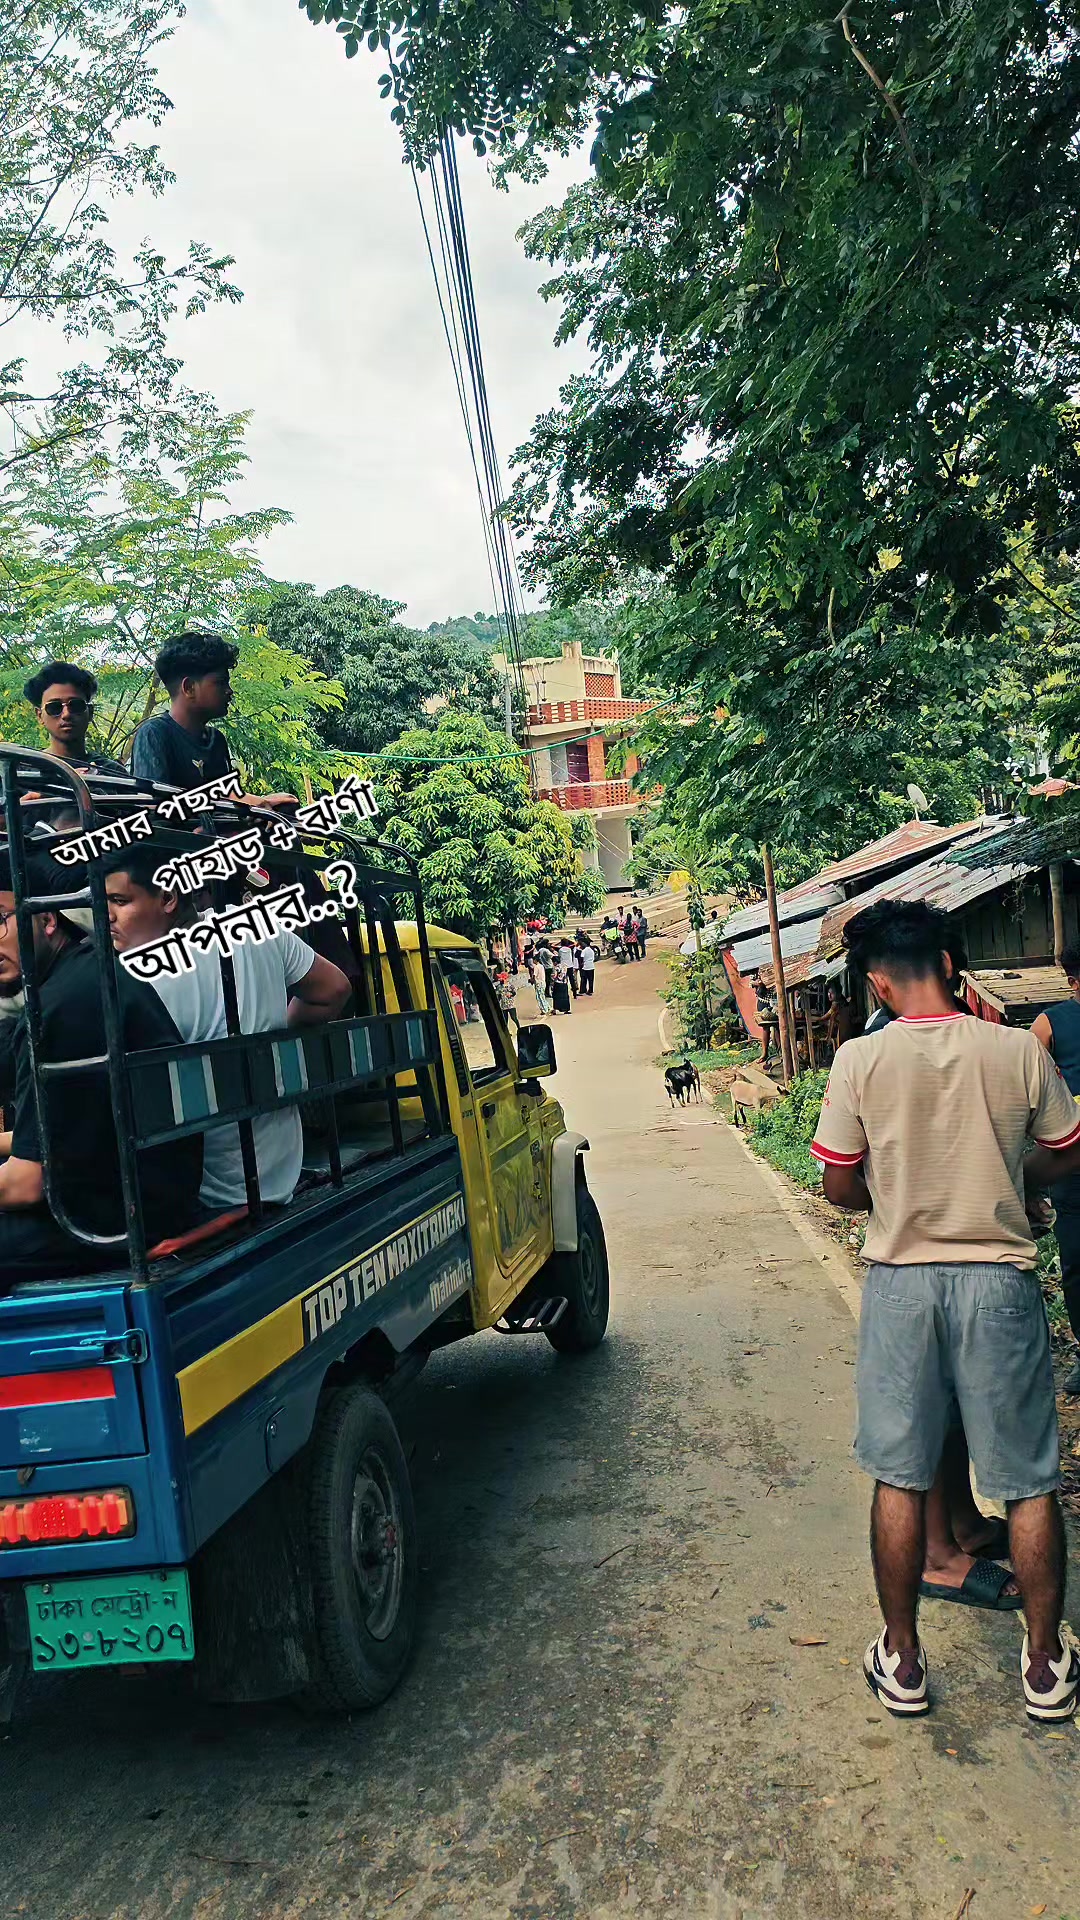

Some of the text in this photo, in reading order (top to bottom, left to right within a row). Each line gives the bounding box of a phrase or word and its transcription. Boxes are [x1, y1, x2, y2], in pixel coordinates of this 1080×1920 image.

[304, 1276, 348, 1342] TOP
[348, 1250, 387, 1307] TEN
[36, 1598, 84, 1621] ঢাকা
